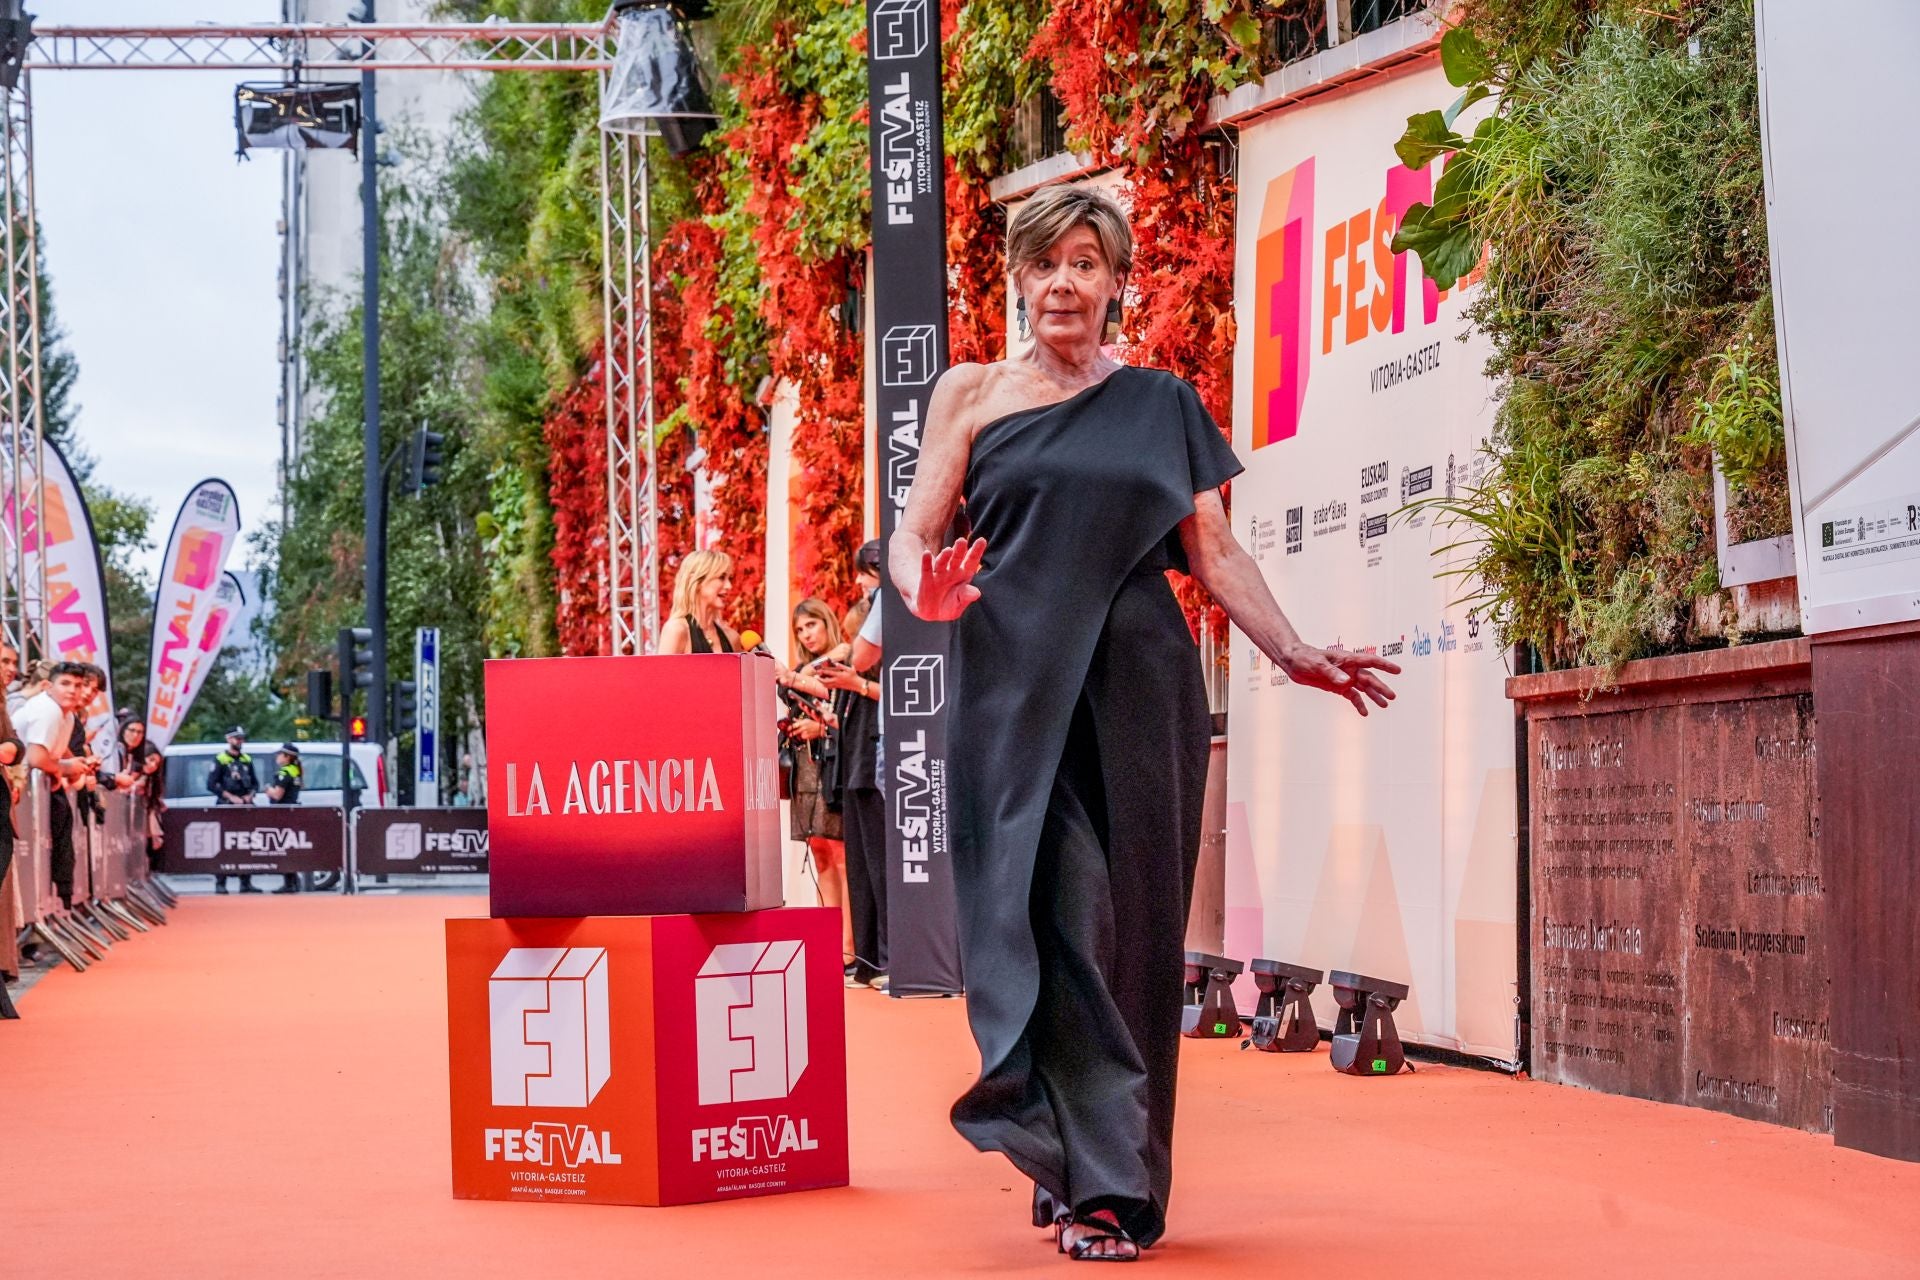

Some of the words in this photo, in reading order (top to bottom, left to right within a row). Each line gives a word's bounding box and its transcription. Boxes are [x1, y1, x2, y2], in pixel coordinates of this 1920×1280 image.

[881, 72, 914, 225] FESTVAL
[915, 100, 926, 195] VITORIA-GASTEIZ
[1370, 341, 1441, 394] VITORIA-GASTEIZ
[1361, 460, 1389, 488] EUSKADI
[150, 593, 196, 728] FESTVAL
[1387, 642, 1403, 656] CORREO
[425, 670, 433, 723] TAXI
[506, 761, 552, 817] LA
[562, 757, 725, 815] AGENCIA
[896, 730, 930, 883] FESTVAL
[931, 759, 941, 854] VITORIA-GASTEIZ
[224, 827, 313, 851] FESTVAL
[1695, 924, 1736, 950] Solanum
[1739, 927, 1806, 956] lycopersicum
[484, 1121, 622, 1168] FESTVAL
[691, 1115, 818, 1162] FESTVAL
[511, 1171, 586, 1184] VITORIA-GASTEIZ
[716, 1162, 787, 1181] VITORIA-GASTEIZ
[748, 1181, 766, 1190] BASQUE
[766, 1180, 786, 1189] COUNTRY
